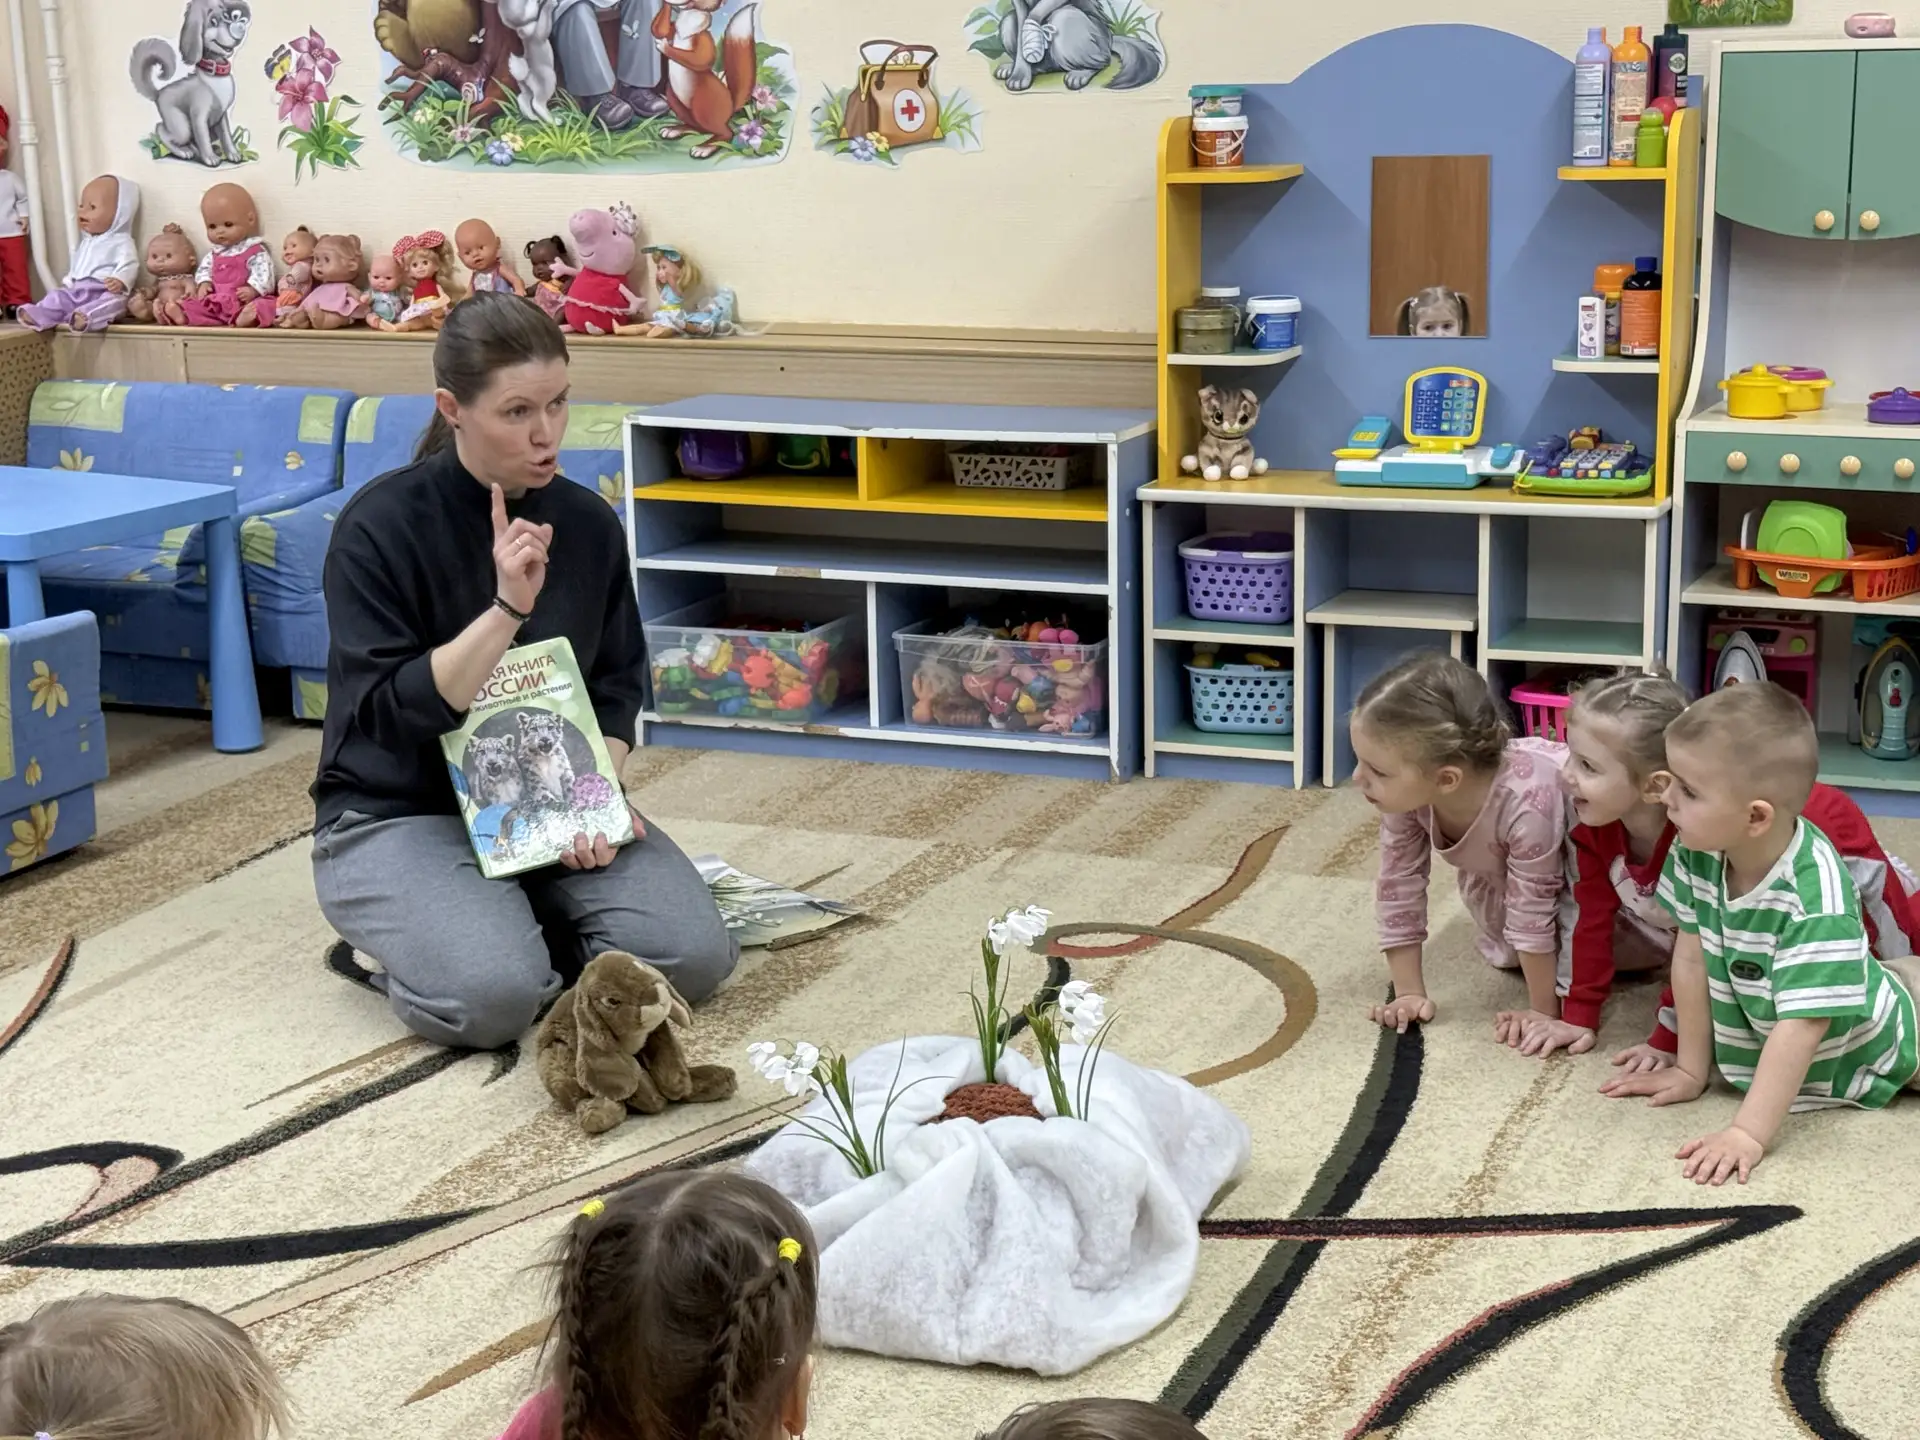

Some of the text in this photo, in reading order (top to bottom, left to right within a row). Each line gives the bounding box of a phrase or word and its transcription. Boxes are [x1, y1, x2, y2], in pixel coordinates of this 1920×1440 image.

[507, 654, 557, 676] КНИГА
[473, 670, 547, 702] ОССИИ
[530, 682, 573, 700] растения
